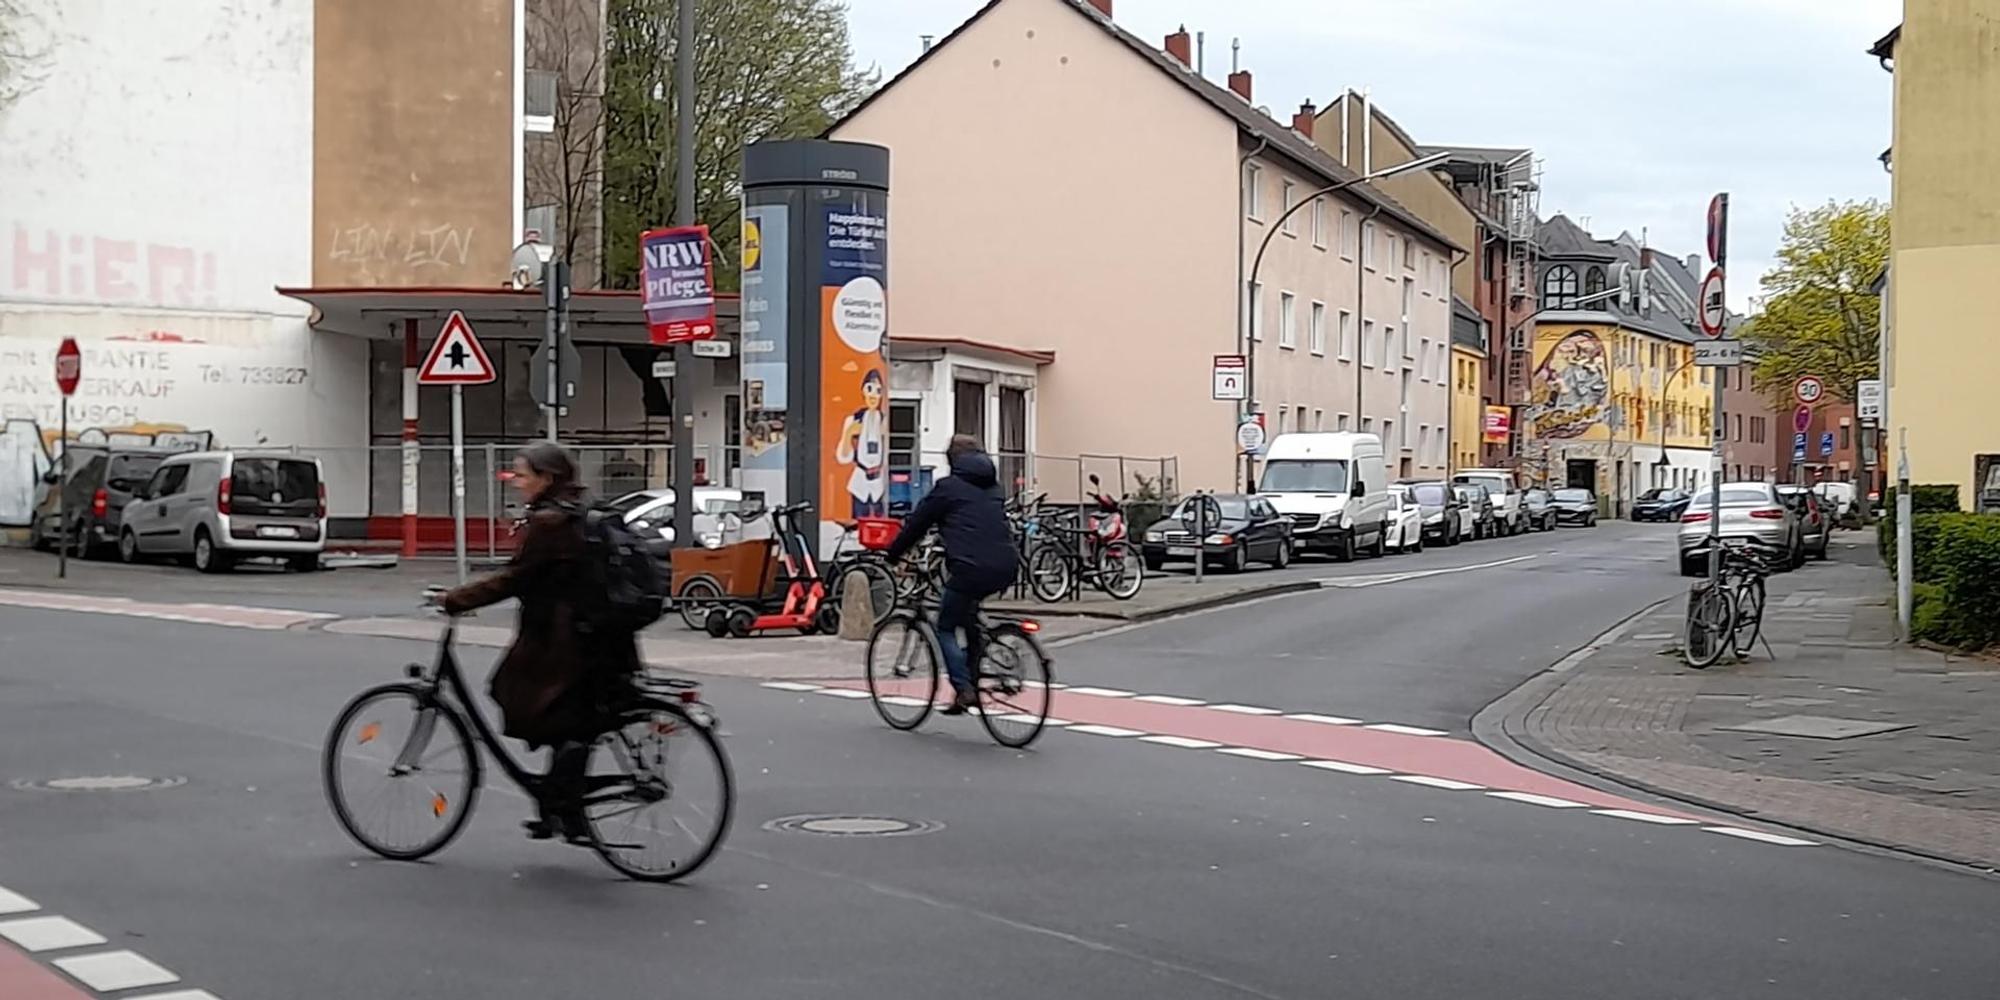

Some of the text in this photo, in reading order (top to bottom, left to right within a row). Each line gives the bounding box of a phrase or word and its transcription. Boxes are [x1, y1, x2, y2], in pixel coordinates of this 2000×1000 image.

[829, 225, 846, 236] Die
[644, 240, 706, 269] NRW
[1801, 383, 1818, 397] 30
